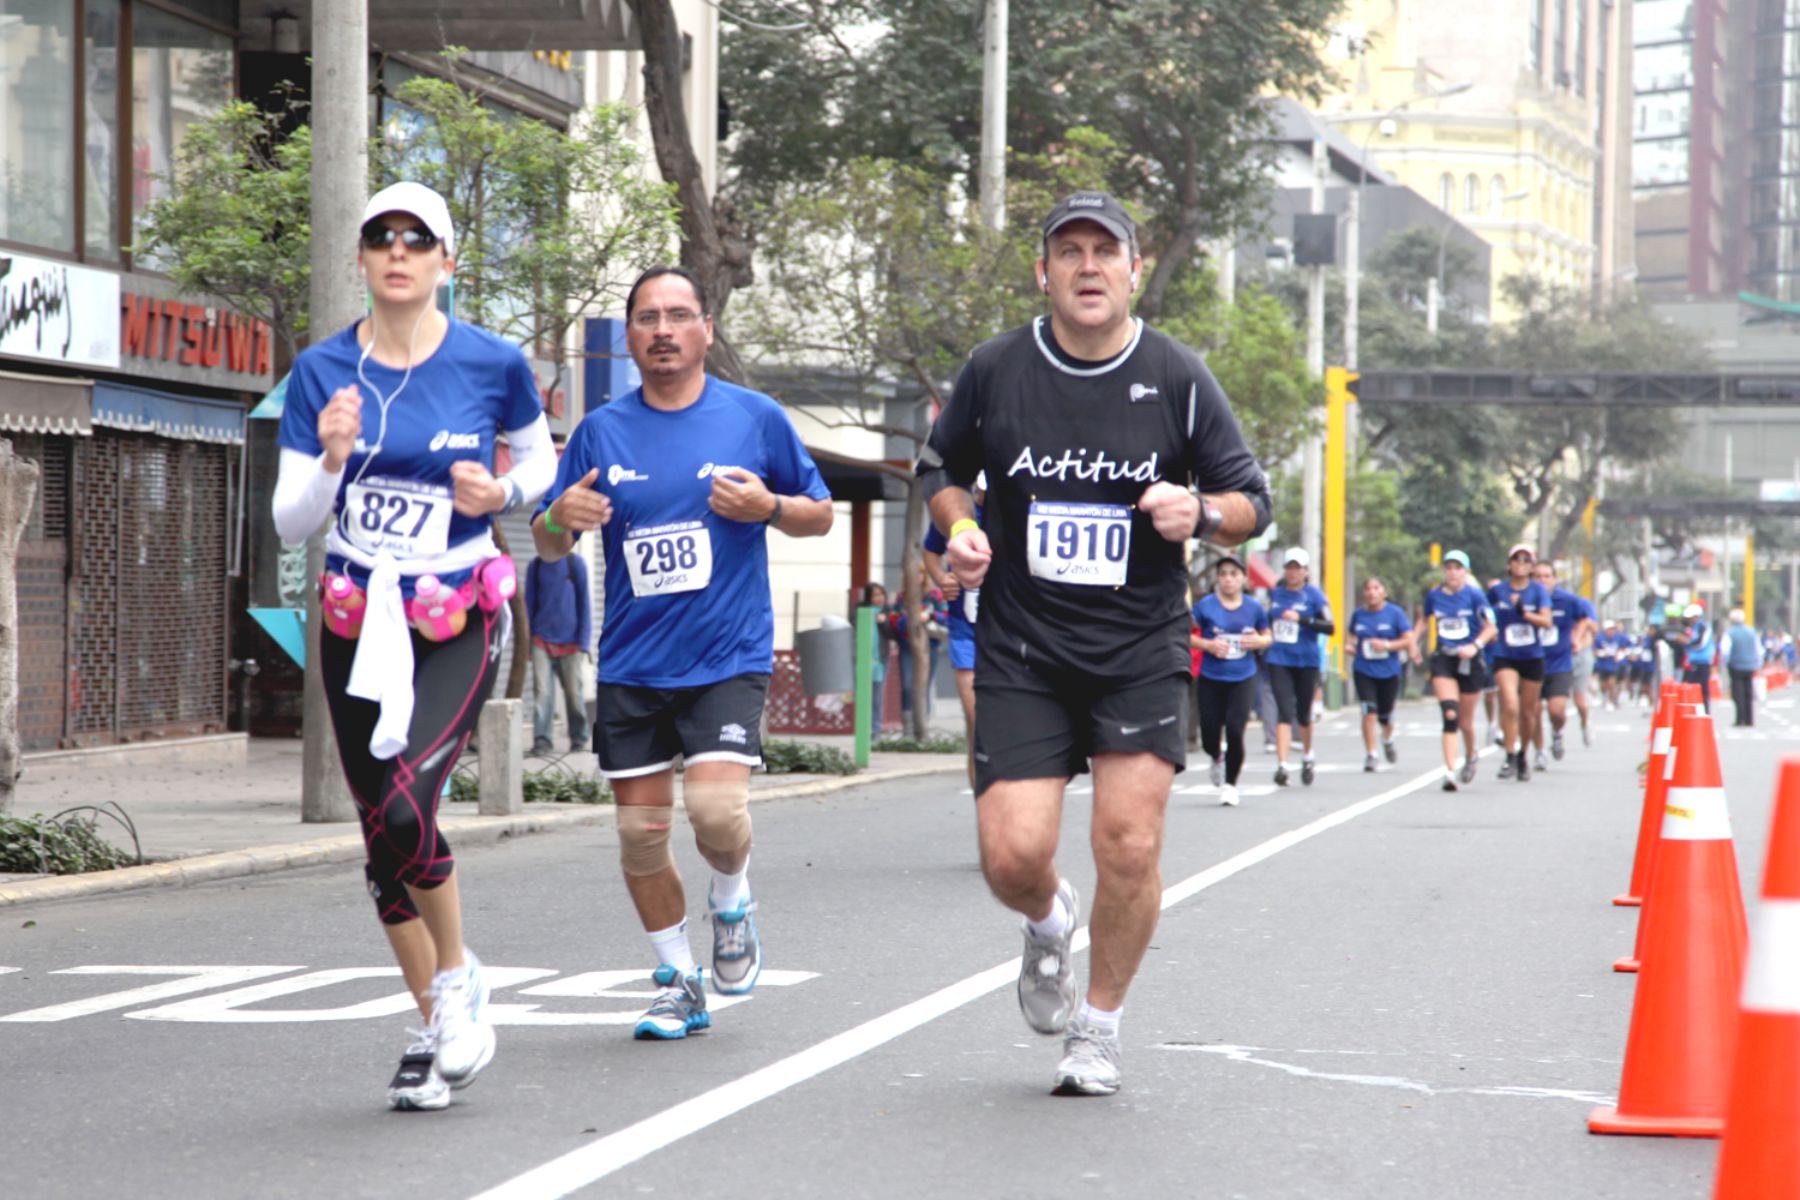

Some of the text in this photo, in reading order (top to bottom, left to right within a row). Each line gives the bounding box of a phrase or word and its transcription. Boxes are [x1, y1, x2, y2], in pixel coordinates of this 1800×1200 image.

[121, 293, 270, 375] MITSUWA
[1007, 446, 1162, 483] Actitud
[361, 491, 434, 539] 827
[636, 535, 697, 576] 298
[1035, 520, 1127, 563] 1910
